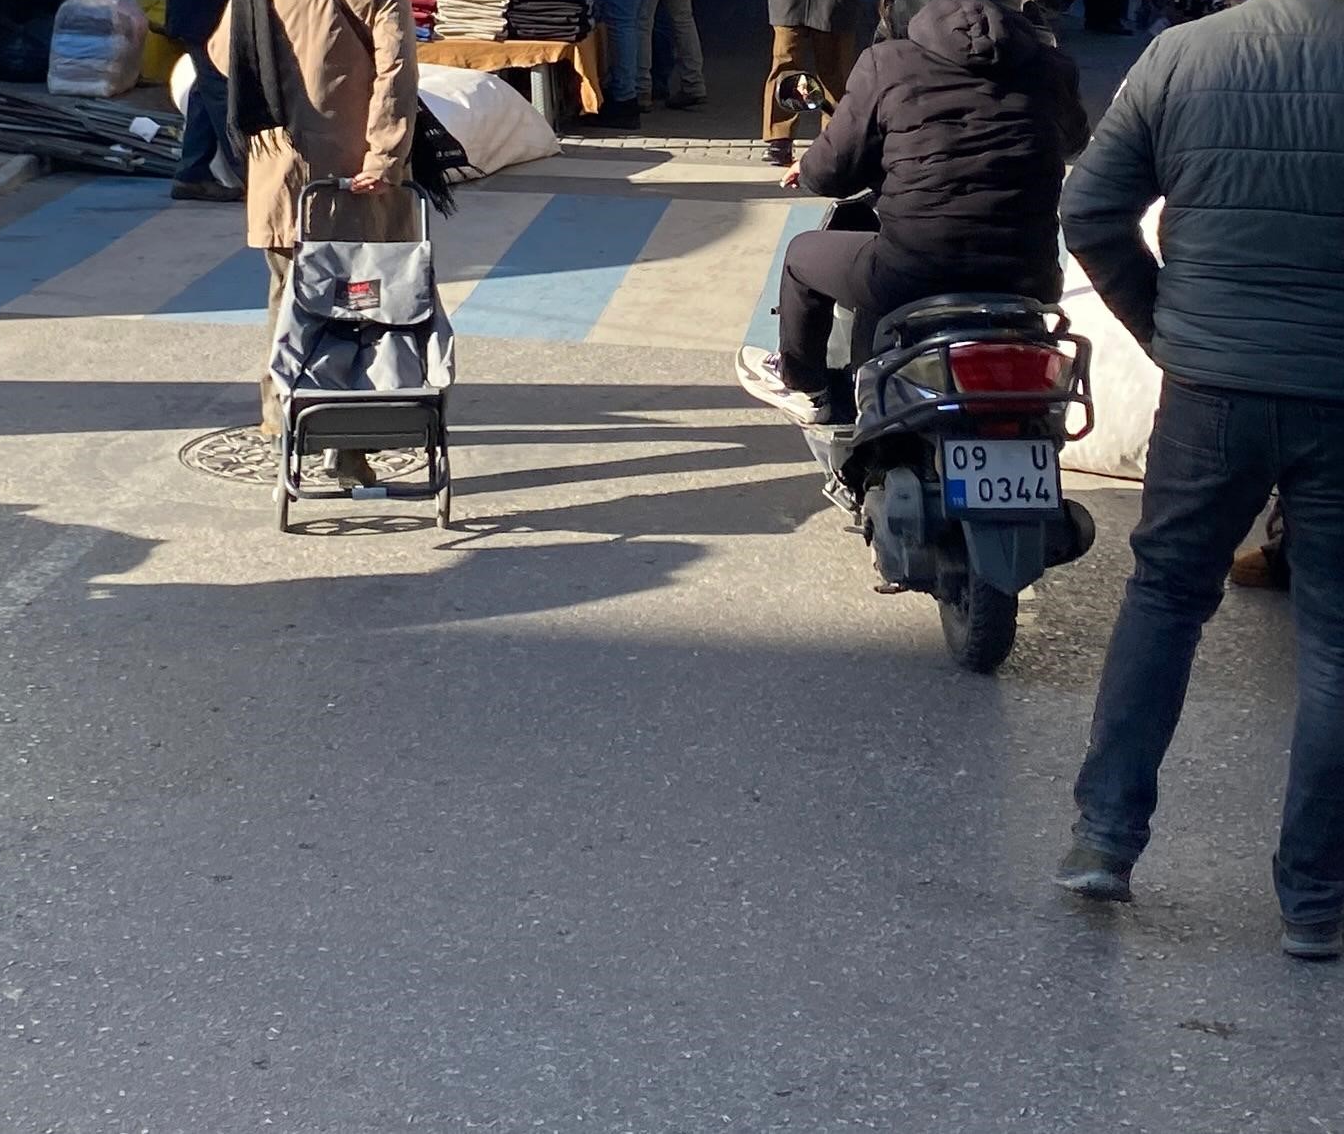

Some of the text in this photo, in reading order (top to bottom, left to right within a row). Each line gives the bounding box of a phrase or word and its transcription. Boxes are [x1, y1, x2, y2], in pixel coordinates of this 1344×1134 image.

[952, 444, 1048, 471] 09 U
[978, 476, 1051, 502] 0344
